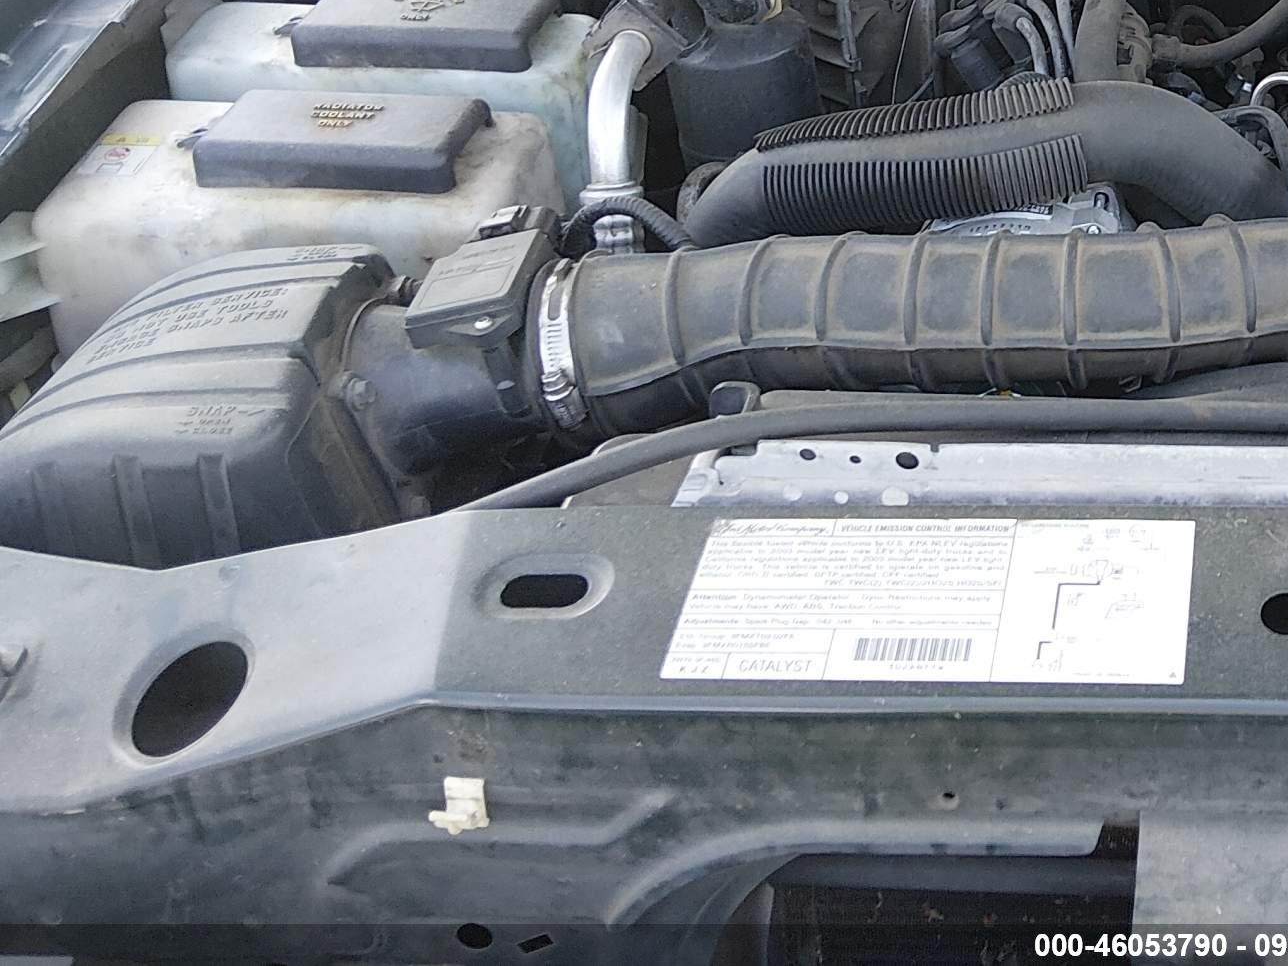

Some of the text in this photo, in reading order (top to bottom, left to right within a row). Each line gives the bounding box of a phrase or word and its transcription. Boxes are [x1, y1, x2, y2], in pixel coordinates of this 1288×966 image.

[311, 111, 376, 120] COOLANT
[318, 119, 354, 128] ONLY
[176, 310, 209, 322] USE
[217, 300, 275, 314] TOOLS
[229, 310, 289, 324] AFTER
[186, 406, 237, 417] SNAP
[841, 525, 1009, 533] VEHICLE EMISSION CONTROL INFORMATION
[739, 660, 812, 672] CATALYST
